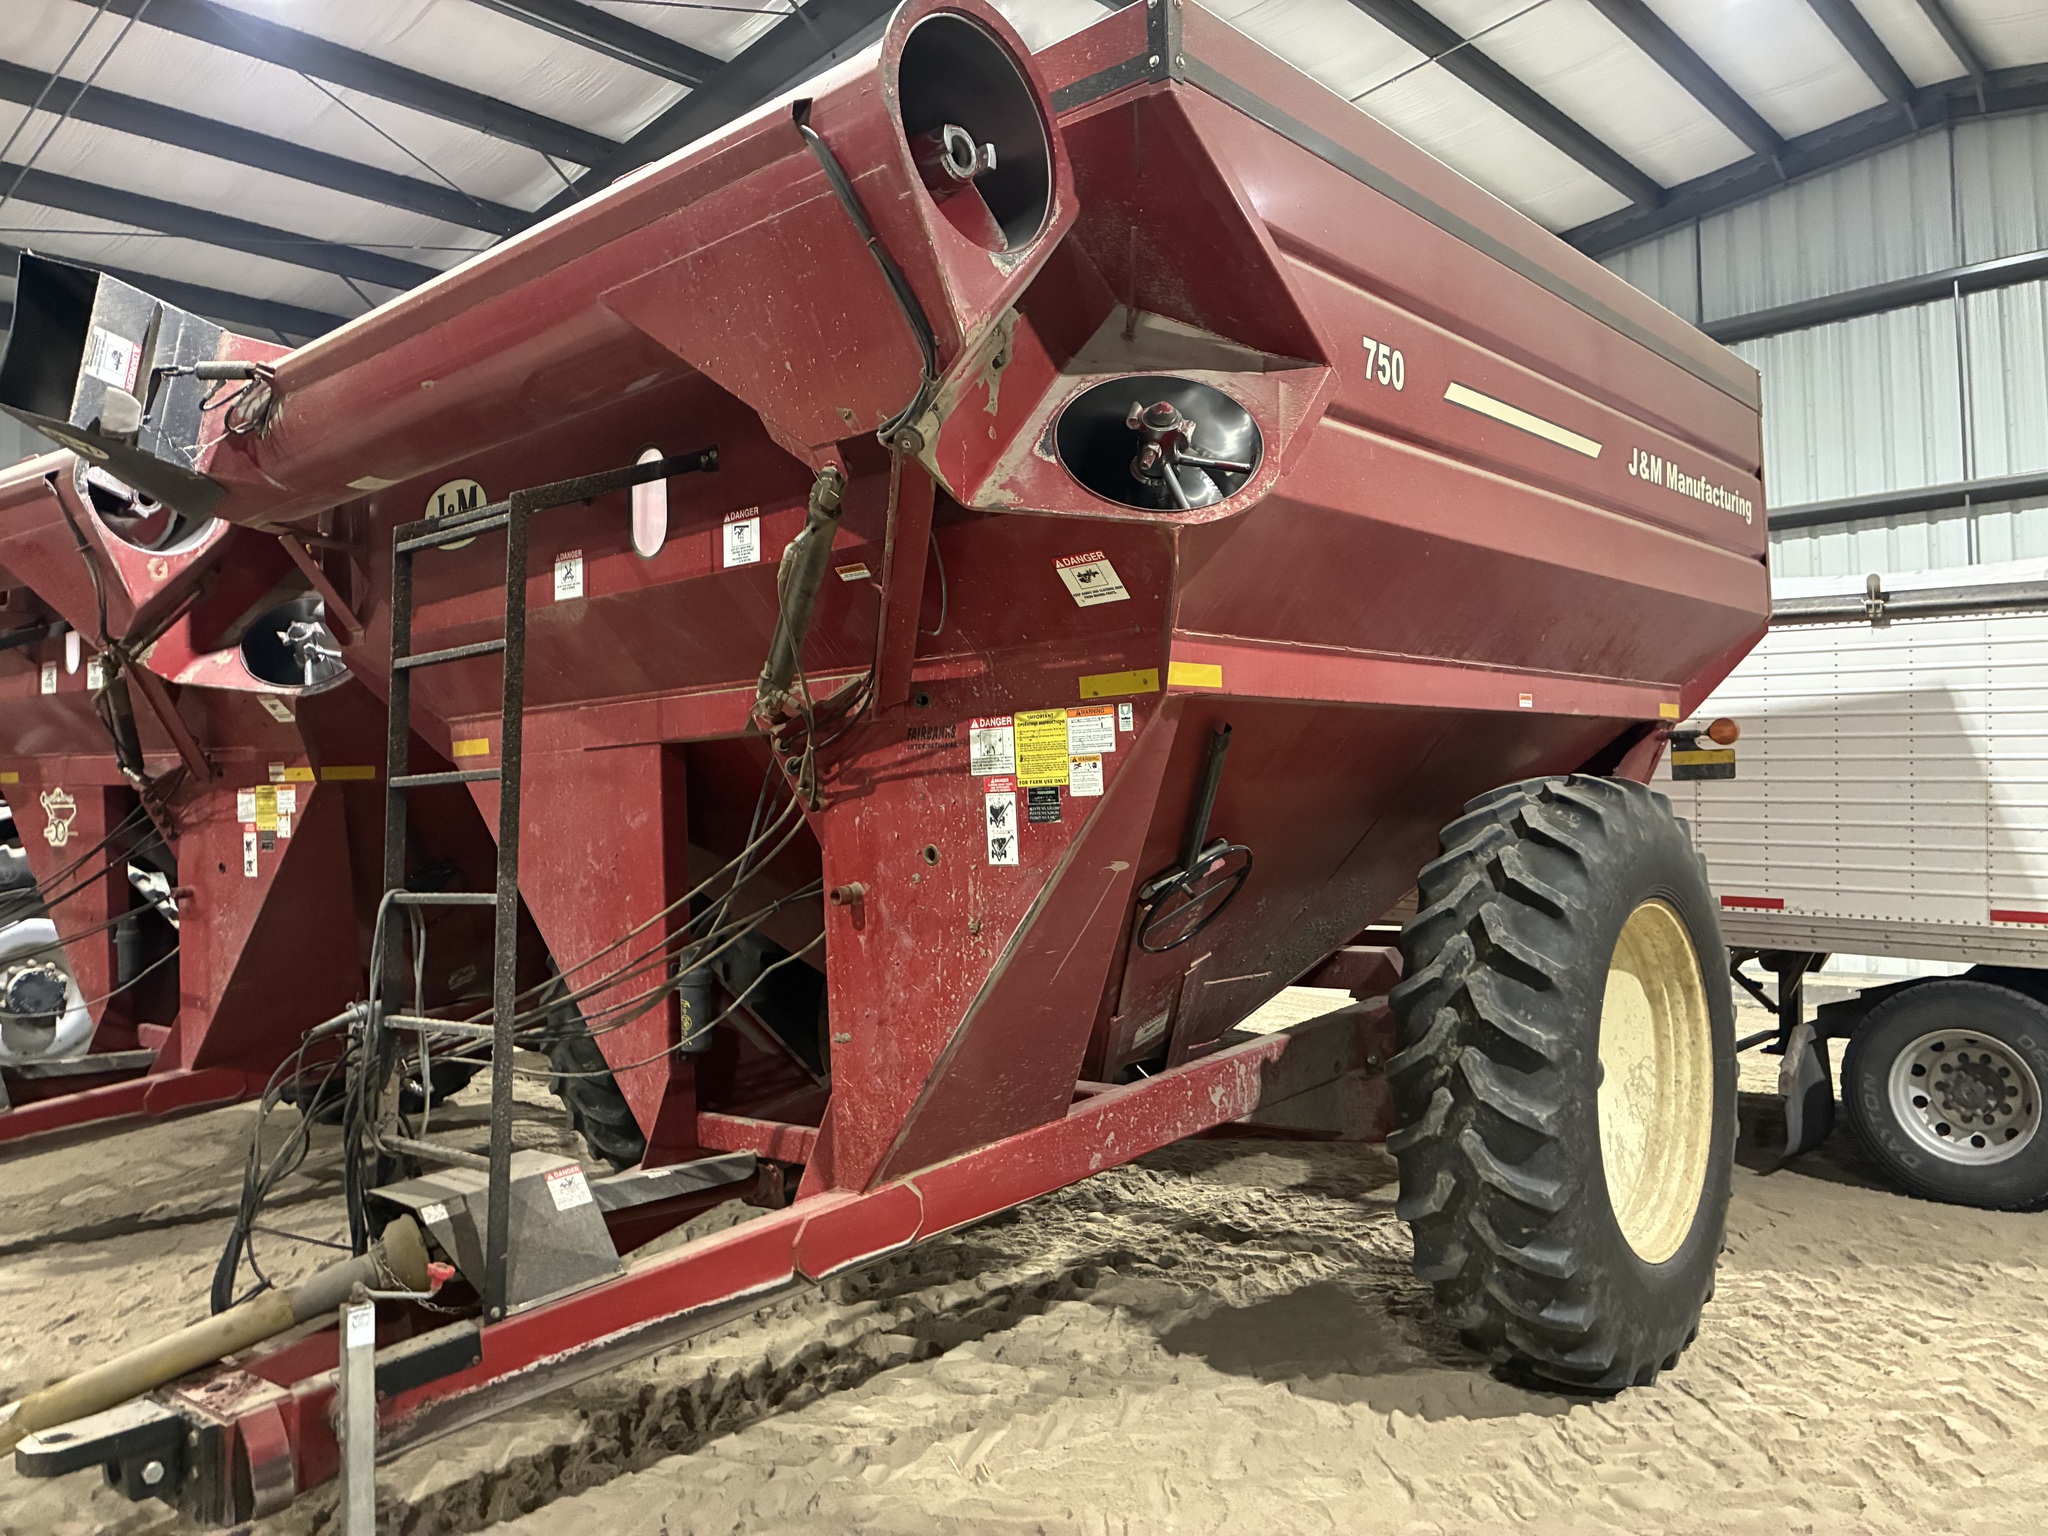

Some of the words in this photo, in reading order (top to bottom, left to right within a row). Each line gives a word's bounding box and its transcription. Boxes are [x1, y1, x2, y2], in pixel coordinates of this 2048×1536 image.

[1362, 335, 1405, 391] 750
[126, 352, 140, 391] DANGER
[1627, 446, 1663, 485] J&M
[1666, 460, 1752, 525] Manufacturing
[730, 506, 759, 520] DANGER
[560, 549, 583, 561] DANGER
[1062, 551, 1105, 566] DANGER
[980, 716, 1012, 728] DANGER
[908, 725, 957, 741] FAIRBANKS
[1863, 1072, 1923, 1169] DAYTON
[554, 1166, 580, 1178] DANGER
